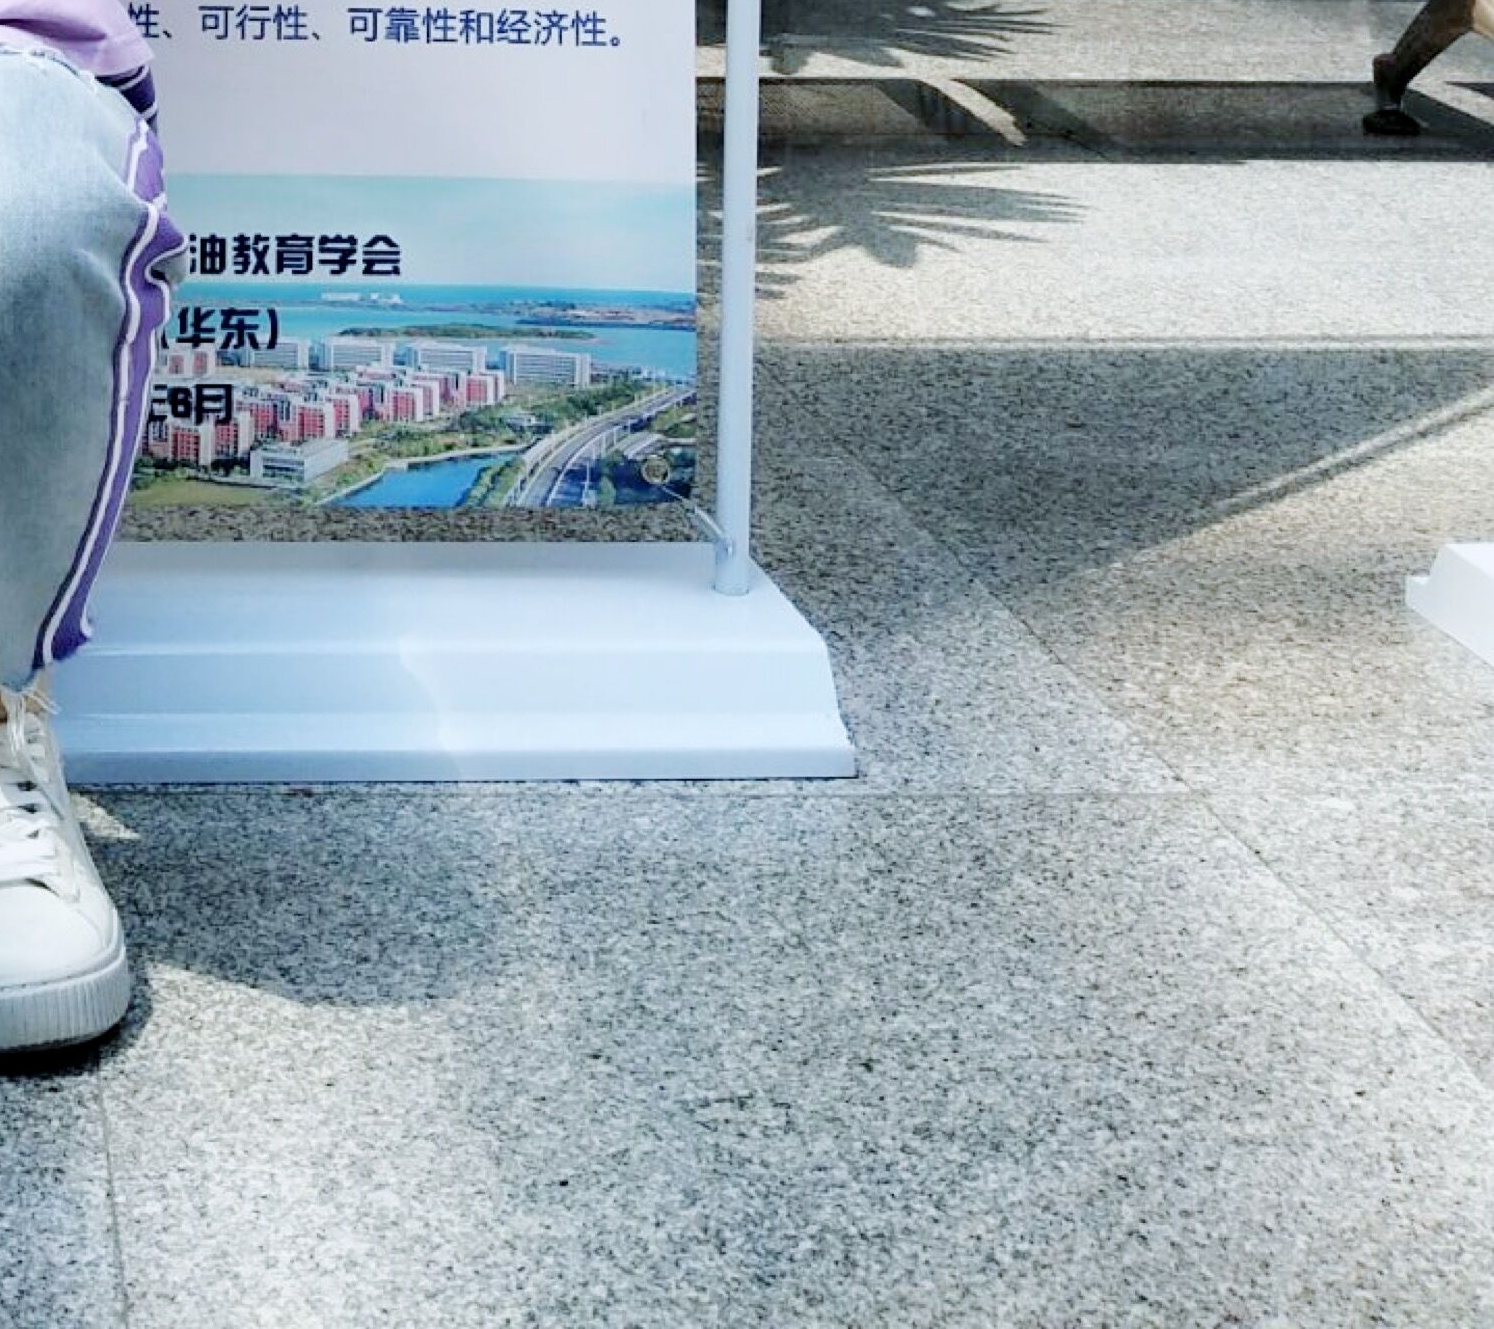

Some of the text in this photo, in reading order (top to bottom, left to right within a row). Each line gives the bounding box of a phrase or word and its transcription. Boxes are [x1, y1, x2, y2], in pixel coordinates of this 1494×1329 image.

[189, 232, 402, 276] 油教育学会
